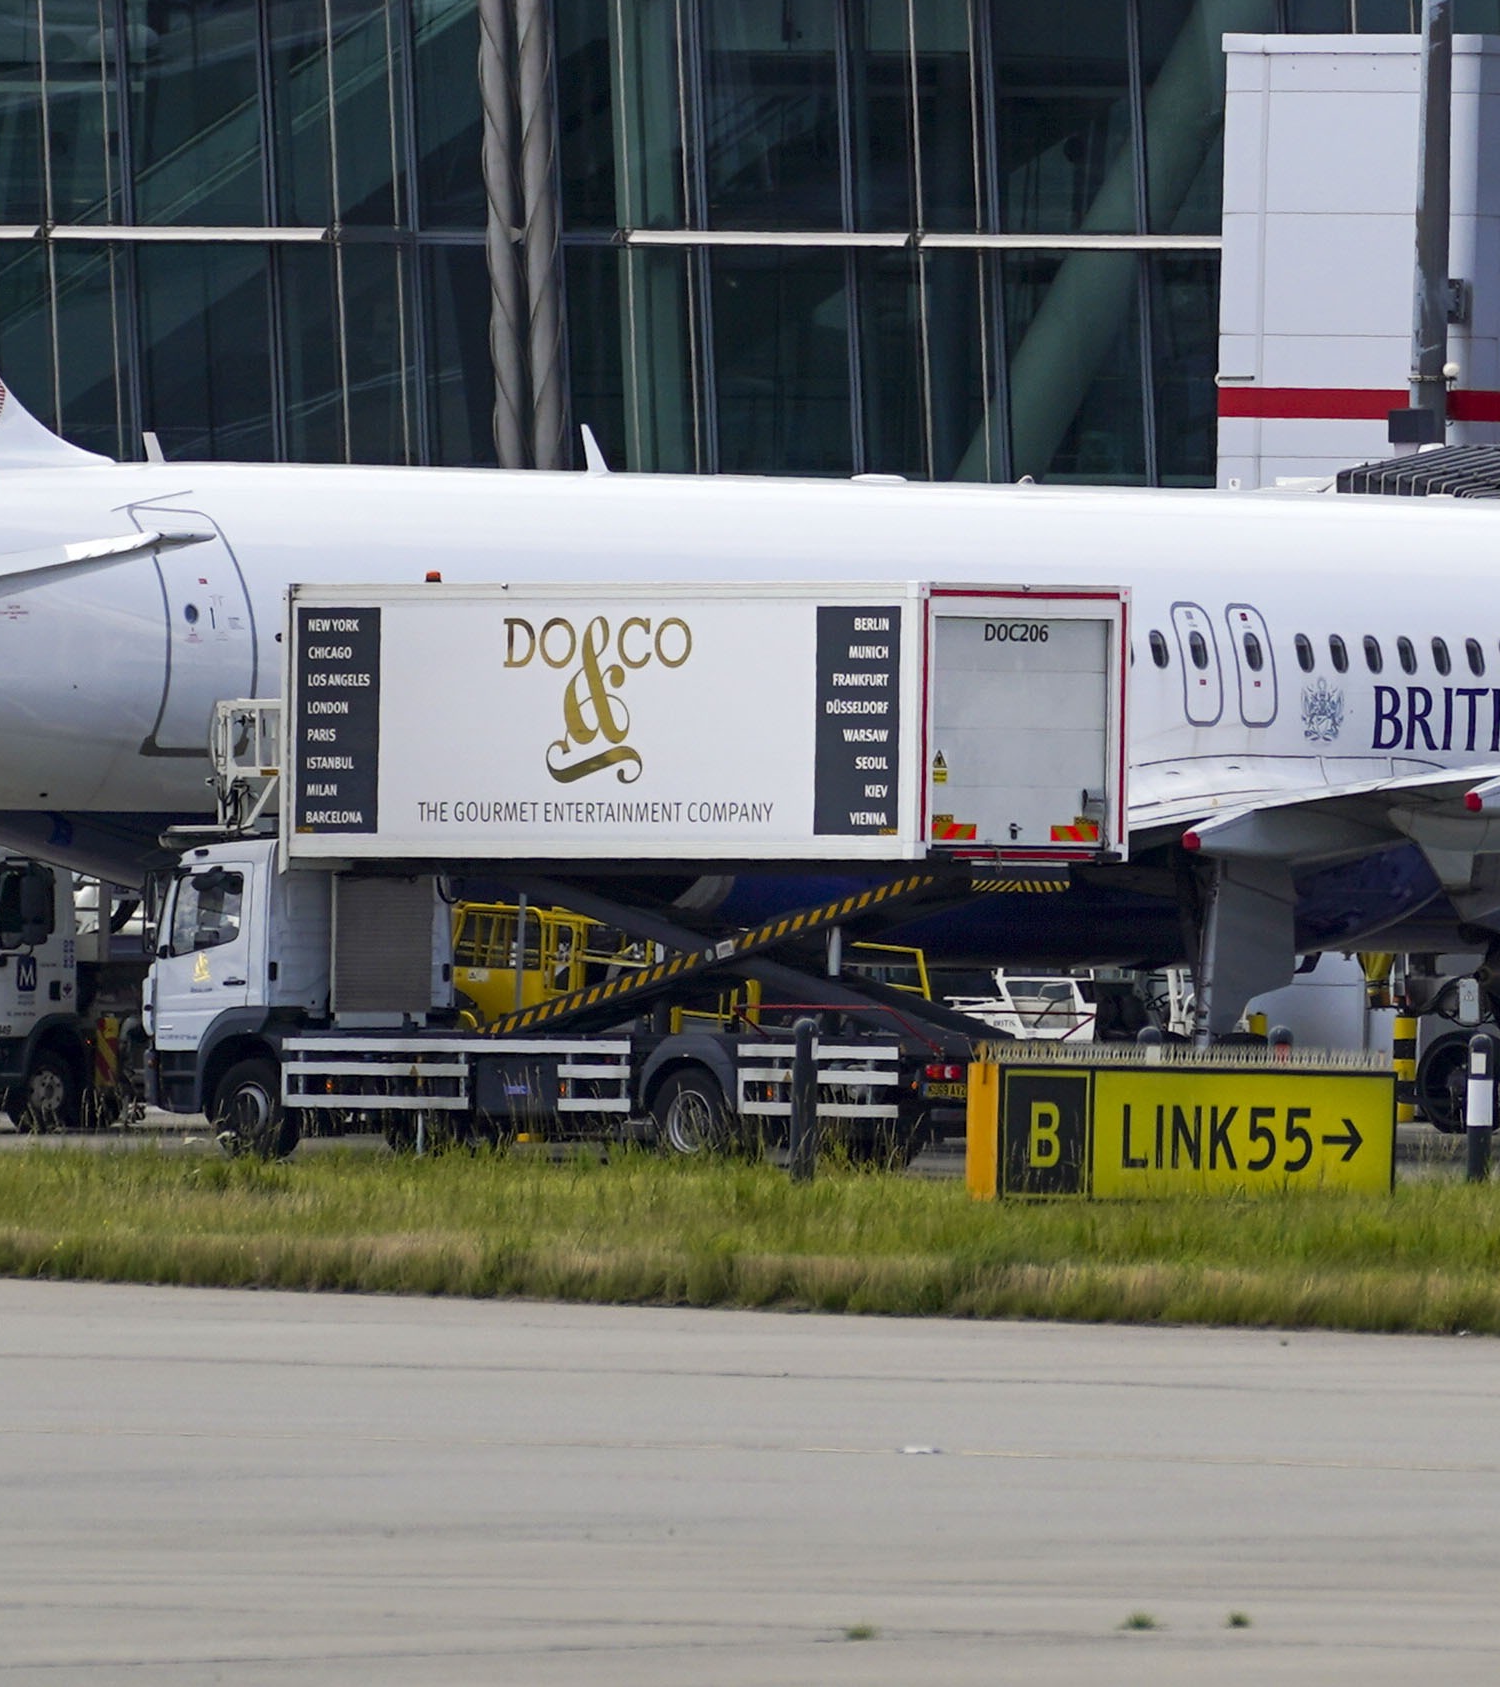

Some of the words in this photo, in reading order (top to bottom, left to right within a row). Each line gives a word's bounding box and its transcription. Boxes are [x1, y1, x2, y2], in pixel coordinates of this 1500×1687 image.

[308, 619, 331, 632] NEW
[332, 619, 360, 632] YORK
[854, 617, 890, 631] BERLIN
[984, 623, 1049, 642] DOC206
[308, 646, 353, 660] CHICAGO
[849, 645, 889, 659] MUNICH
[307, 673, 328, 687] LOS
[328, 673, 371, 687] ANGELES
[832, 673, 889, 687] FRANKFURT
[307, 701, 349, 715] LONDON
[826, 699, 889, 714] DÜSSELDORF
[307, 728, 337, 743] PARIS
[842, 729, 889, 743] WARSAW
[306, 756, 354, 770] ISTANBUL
[855, 756, 889, 770] SEOUL
[306, 783, 338, 797] MILAN
[864, 784, 888, 798] KIEV
[305, 811, 363, 824] BARCELONA
[418, 801, 449, 823] THE
[453, 801, 539, 823] GOURMET
[544, 801, 683, 824] ENTERTAINMENT
[686, 801, 775, 823] COMPANY
[849, 812, 888, 826] VIENNA
[1029, 1101, 1061, 1169] B
[1121, 1103, 1314, 1173] LINK55
